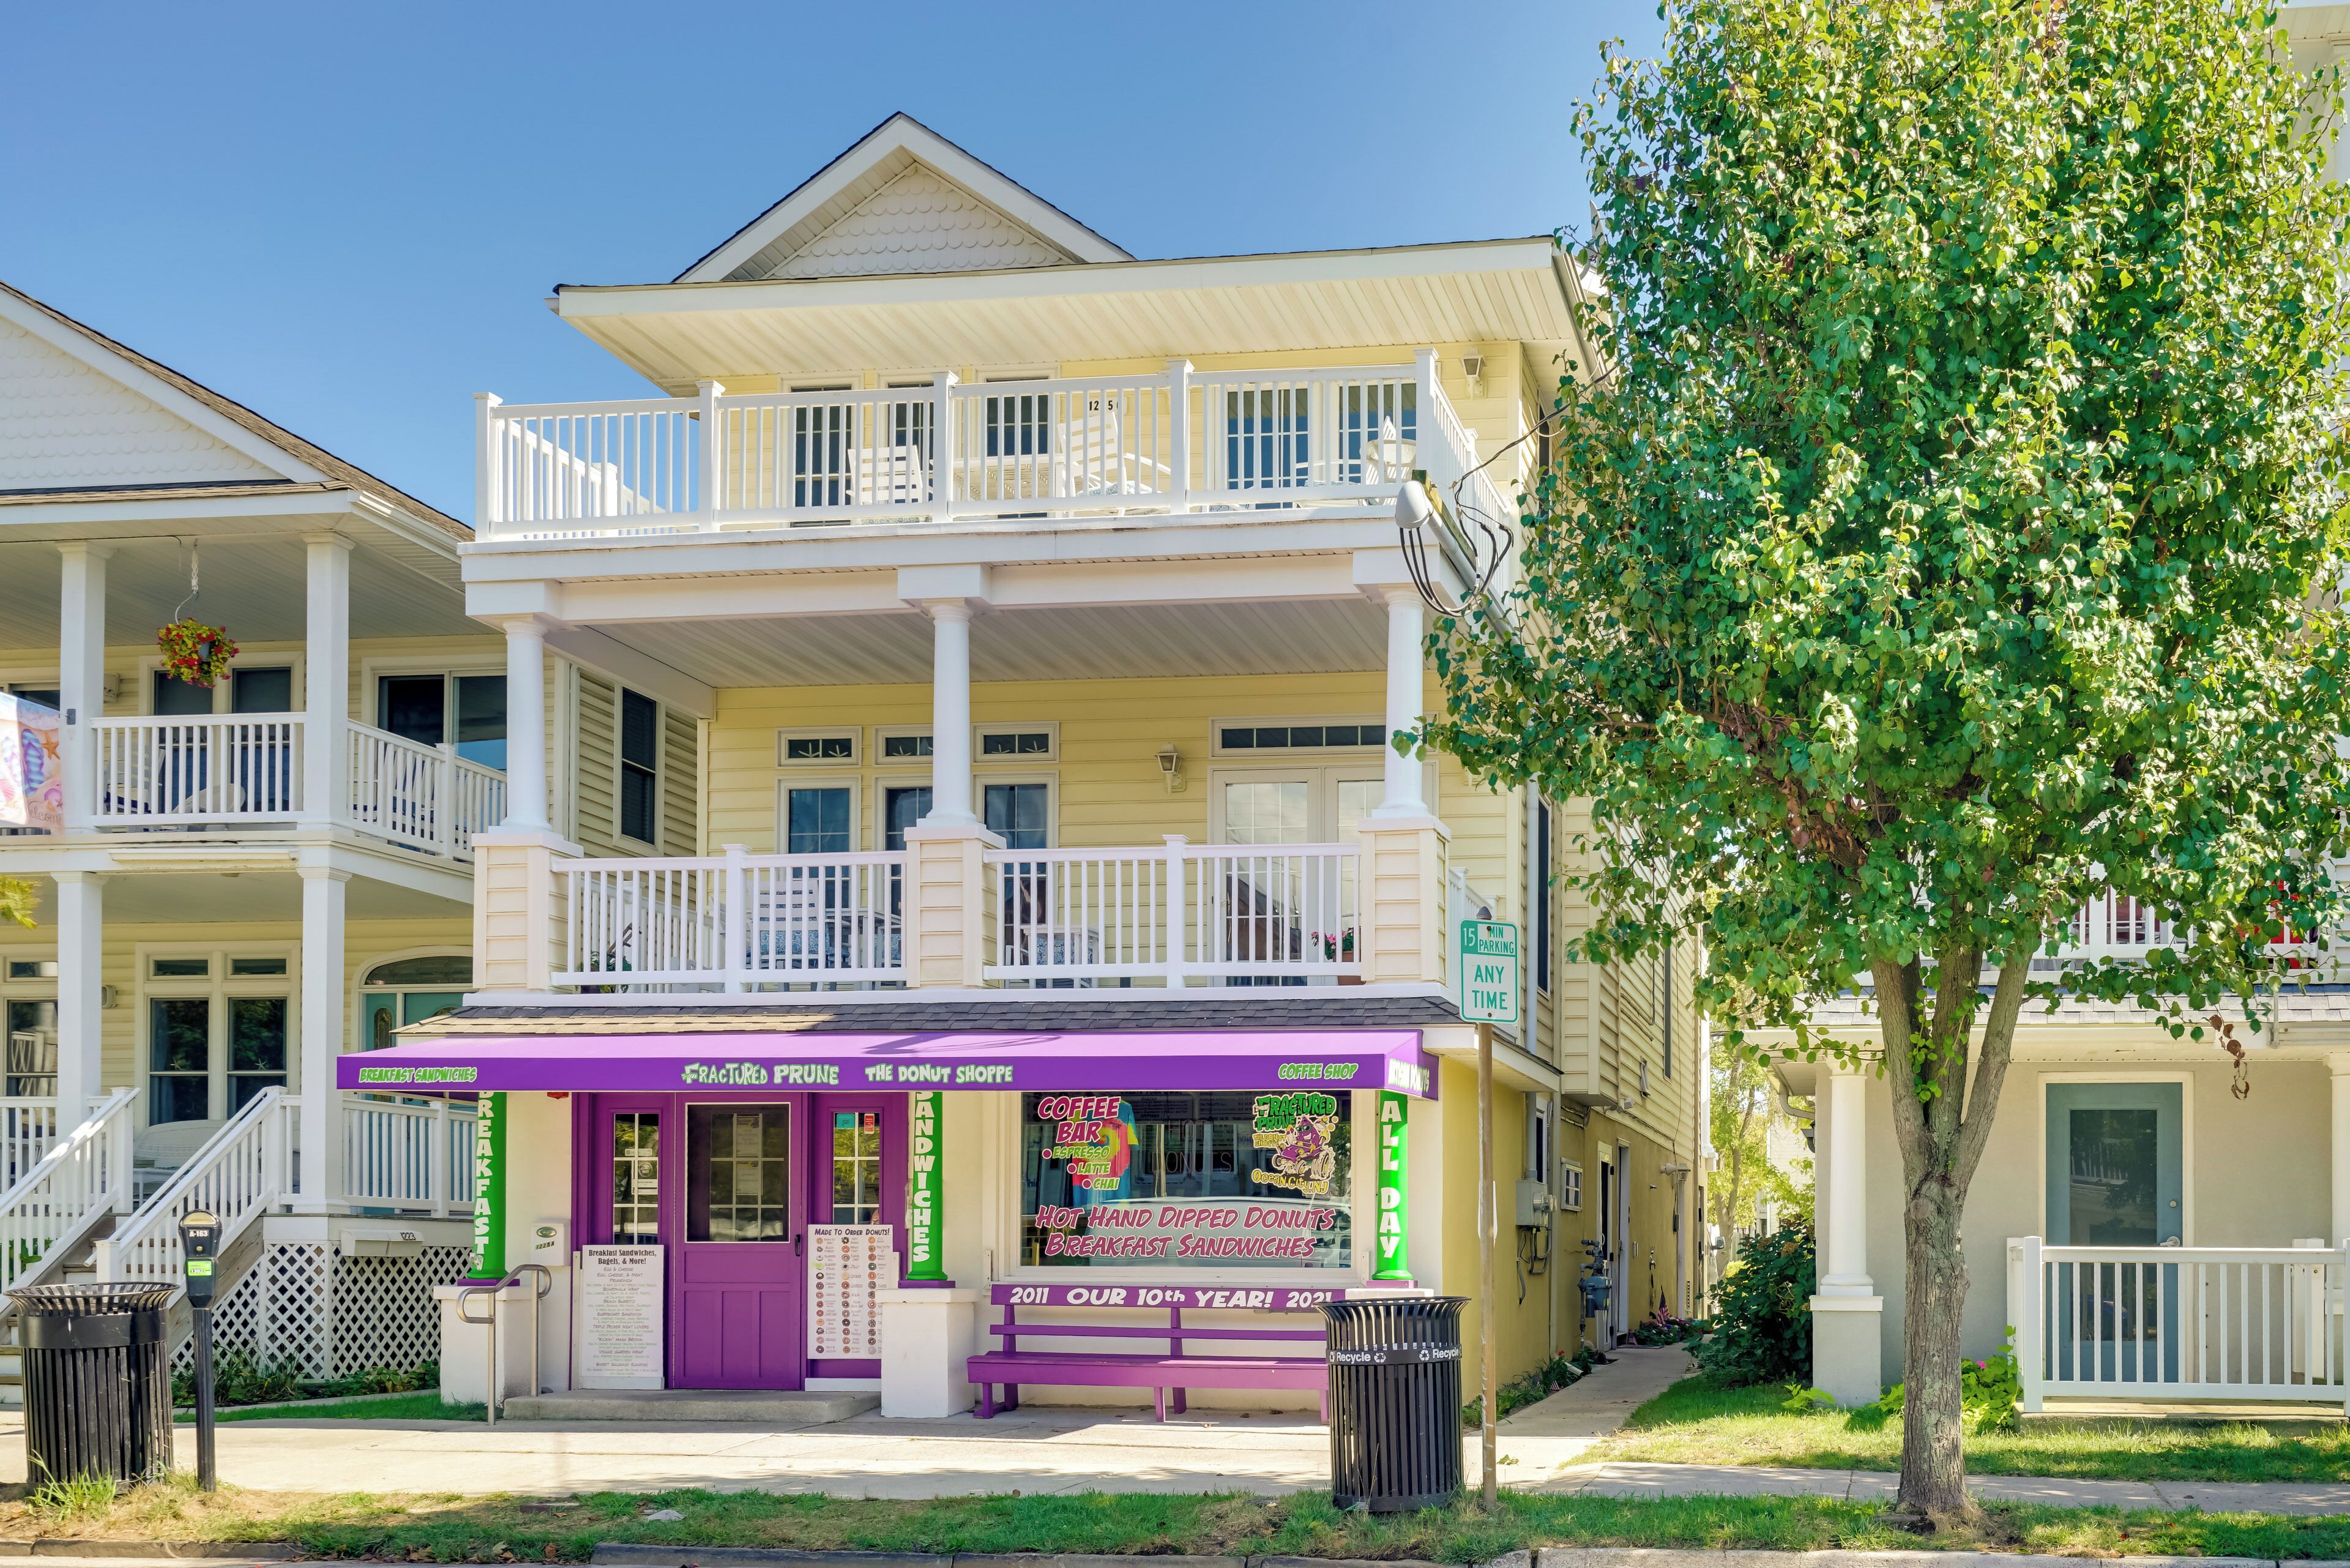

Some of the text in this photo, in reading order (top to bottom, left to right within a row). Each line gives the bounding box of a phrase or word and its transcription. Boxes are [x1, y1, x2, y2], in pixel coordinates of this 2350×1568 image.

[1463, 927, 1476, 947] 15
[1489, 926, 1504, 939] MIN
[1479, 939, 1514, 954] PARKING
[1474, 965, 1504, 984] ANY
[1472, 990, 1508, 1010] TIME
[359, 1067, 477, 1083] BREAKFAST SANDWICHES
[681, 1061, 840, 1086] FRACTURED PRUNE
[864, 1063, 1013, 1084] THE DONUT SHOPPE
[1278, 1062, 1359, 1080] COFFEE SHOP
[1038, 1096, 1121, 1119] COFFEE
[1254, 1092, 1336, 1116] FRACTURED
[1056, 1121, 1102, 1143] BAR
[1256, 1115, 1296, 1130] PRUNE
[1381, 1100, 1402, 1171] ALL
[1052, 1145, 1110, 1159] ESPRESSO
[1076, 1162, 1111, 1175] LATTE
[1092, 1177, 1120, 1191] CHAI
[1035, 1205, 1336, 1230] HOT HAND DIPPED DONUTS
[1379, 1187, 1401, 1258] DAY
[400, 1232, 416, 1241] 1223
[536, 1241, 554, 1250] 1225A
[1044, 1232, 1318, 1258] BREAKFAST SANDWICHES
[1009, 1287, 1049, 1304] 2011
[1066, 1288, 1128, 1305] OUR
[1137, 1288, 1185, 1305] 10th
[1195, 1291, 1274, 1308] YEAR!
[1337, 1352, 1371, 1364] Recycle
[1433, 1348, 1459, 1359] Recycle
